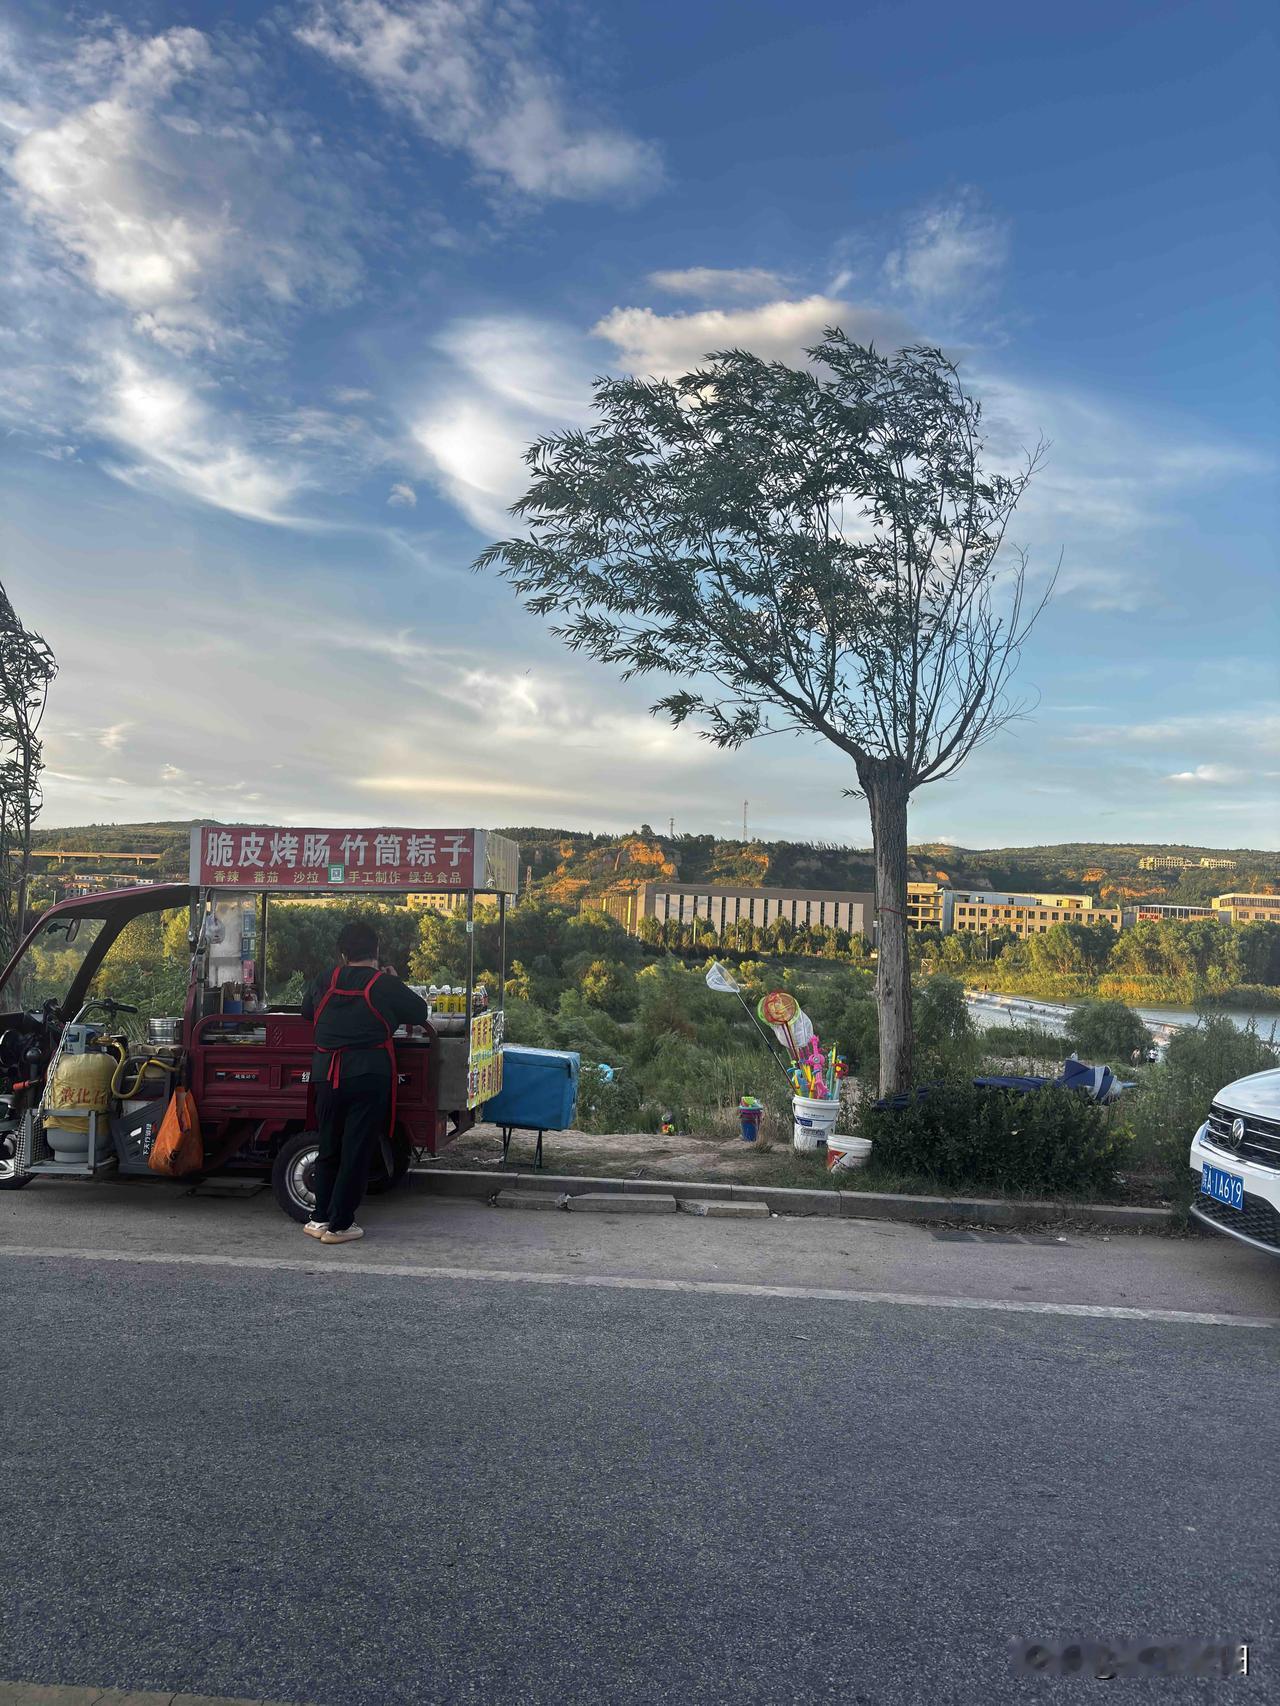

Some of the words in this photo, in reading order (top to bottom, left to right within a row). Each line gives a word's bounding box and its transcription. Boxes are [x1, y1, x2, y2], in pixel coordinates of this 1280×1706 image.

[205, 832, 331, 868] 脆皮烤肠
[340, 833, 471, 867] 竹筒粽子
[213, 870, 240, 884] 香辣
[253, 871, 279, 884] 番茄
[293, 871, 320, 884] 沙拉
[348, 870, 400, 885] 手工制作
[408, 870, 463, 884] 绿色食品
